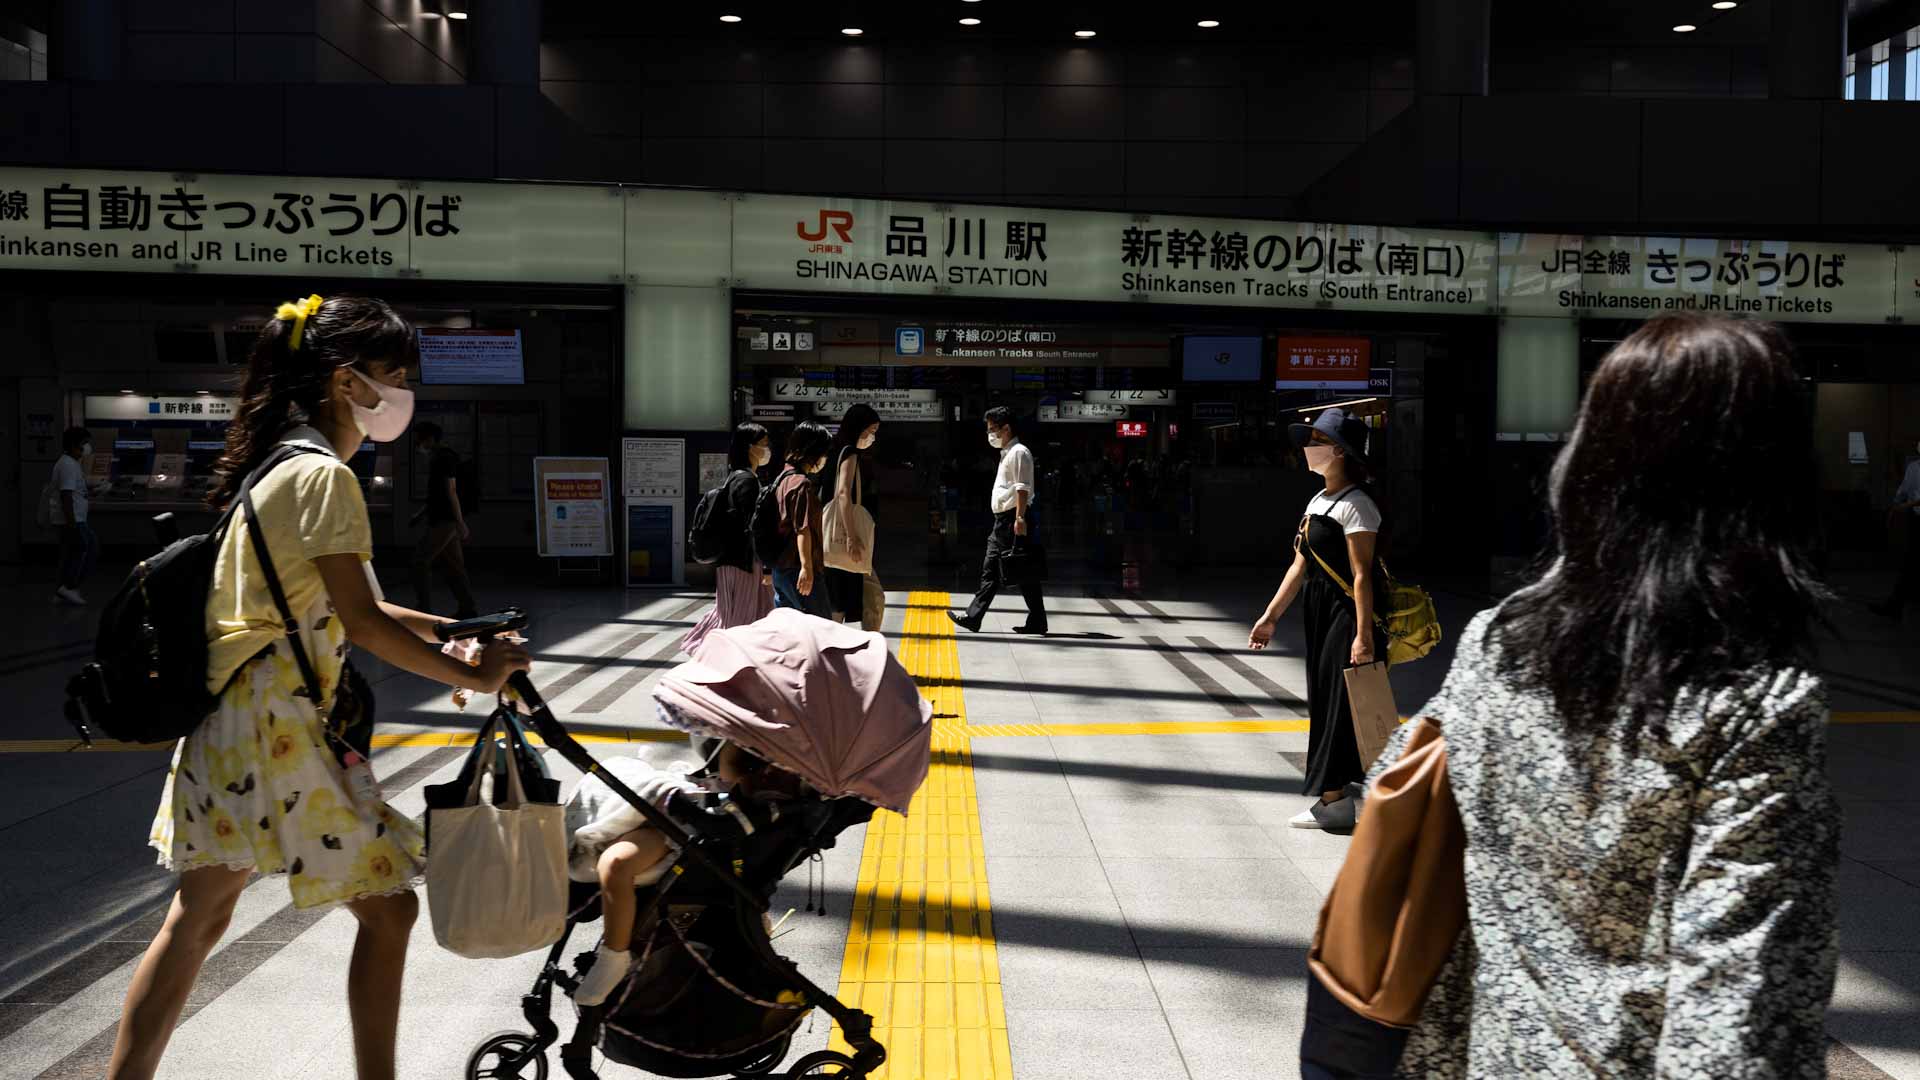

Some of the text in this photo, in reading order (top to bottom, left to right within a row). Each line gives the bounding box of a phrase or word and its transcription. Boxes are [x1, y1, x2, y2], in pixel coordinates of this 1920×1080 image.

[43, 183, 463, 237] 自動きっぷうりば
[796, 209, 854, 243] JR
[886, 215, 1047, 262] 品川駅
[132, 240, 178, 260] and
[191, 241, 222, 261] JR
[235, 242, 287, 263] Line
[299, 244, 393, 266] Tickets
[1121, 226, 1465, 277] 新幹線のりば(南口)
[796, 259, 1047, 287] SHINAGAWA STATION
[1541, 248, 1846, 288] JR全線 きっぷうりば
[1121, 272, 1473, 305] Shinkansen Tracks (South Entrance)
[1558, 290, 1833, 314] Shinkansen and JR Line Tickets
[935, 348, 996, 358] Snkansen
[1000, 348, 1034, 358] Tracks
[795, 383, 808, 396] 23
[816, 386, 829, 396] 24
[164, 402, 203, 414] 新幹線
